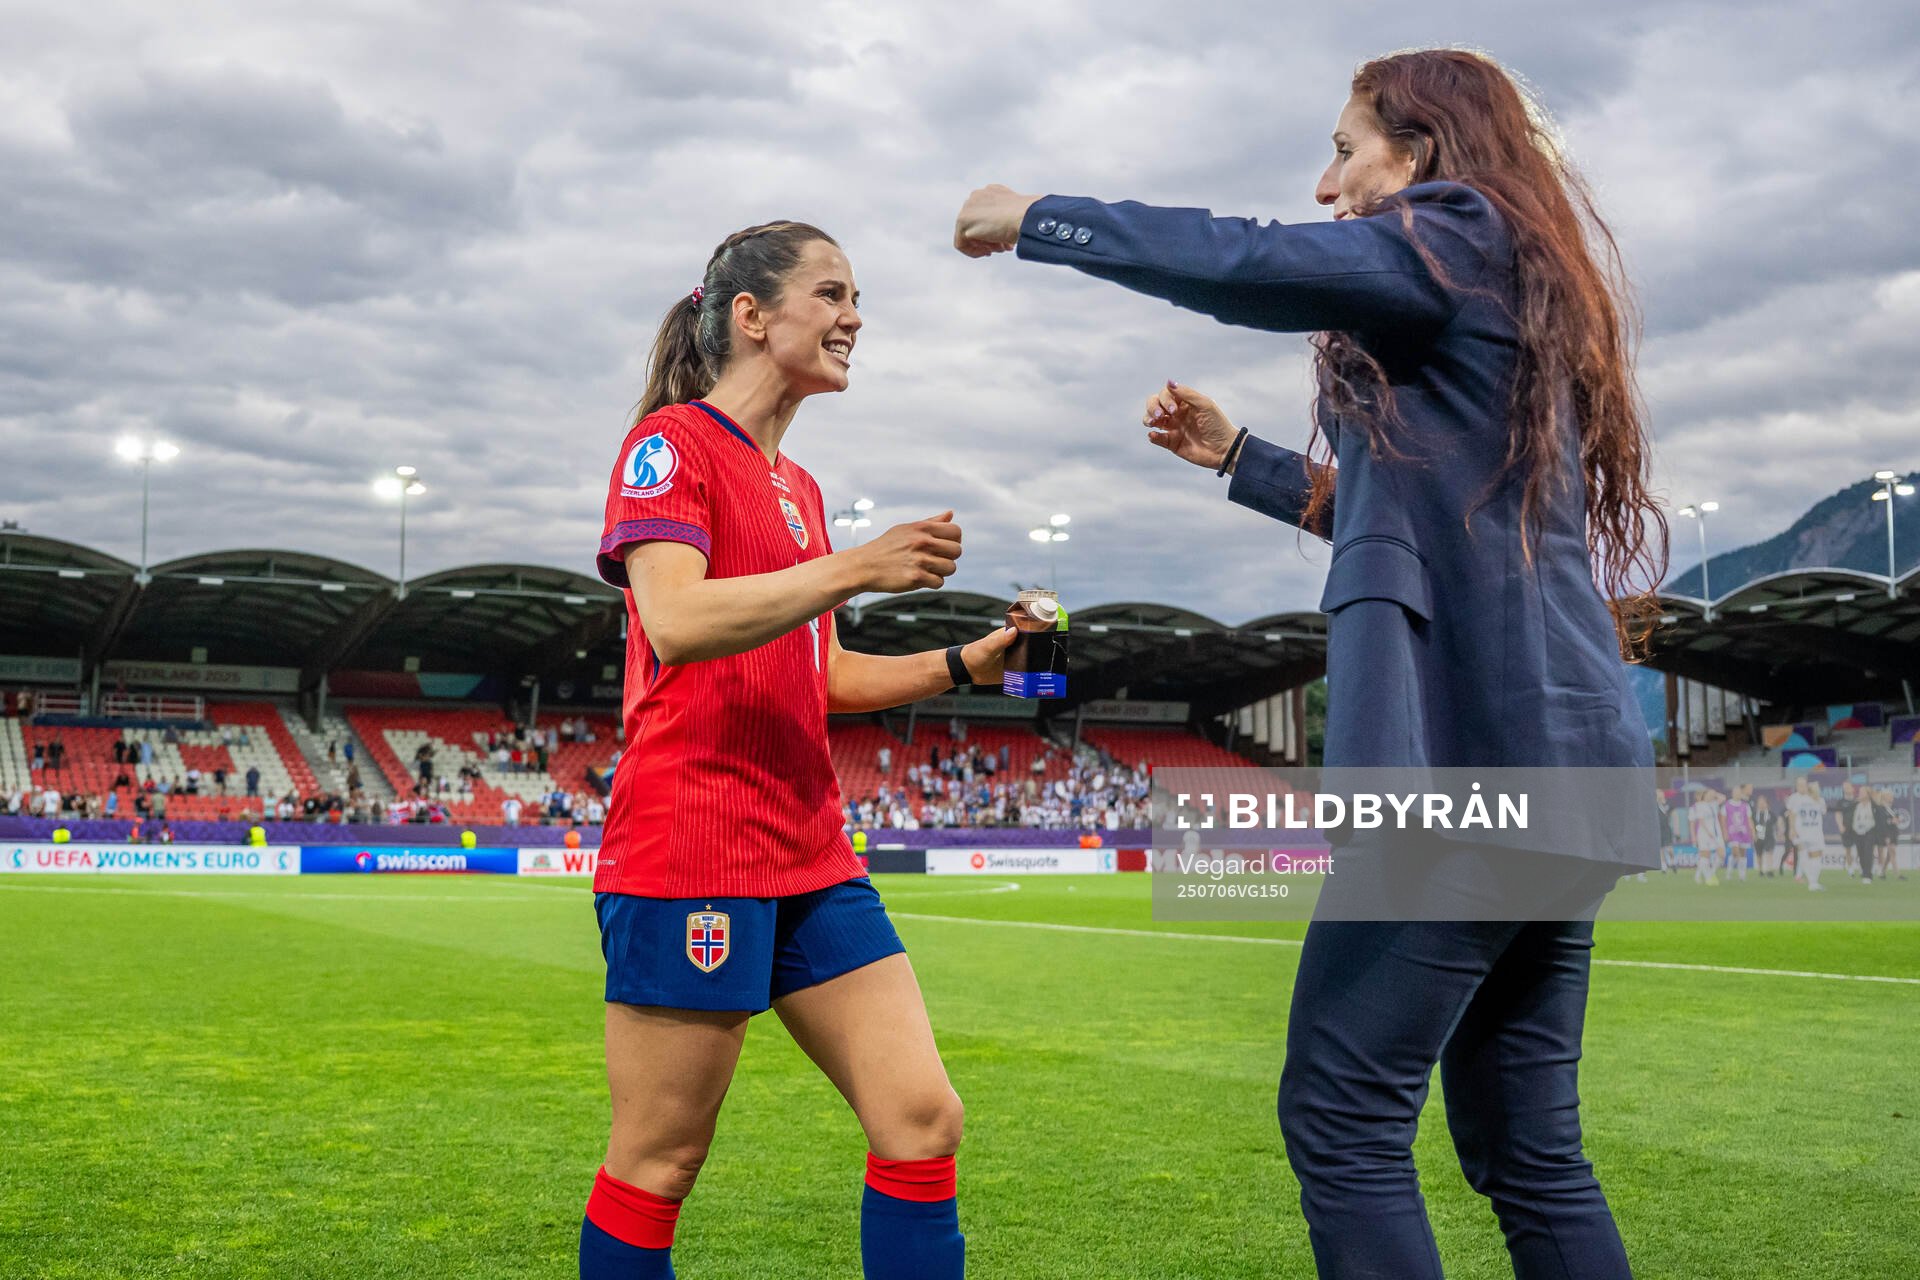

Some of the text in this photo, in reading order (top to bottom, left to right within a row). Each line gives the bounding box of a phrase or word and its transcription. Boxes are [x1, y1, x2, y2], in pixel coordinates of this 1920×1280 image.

[655, 483, 670, 494] 2025
[36, 850, 261, 869] UEFA WOMEN'S EURO
[376, 850, 467, 870] swisscom
[986, 853, 1059, 869] Swissquote
